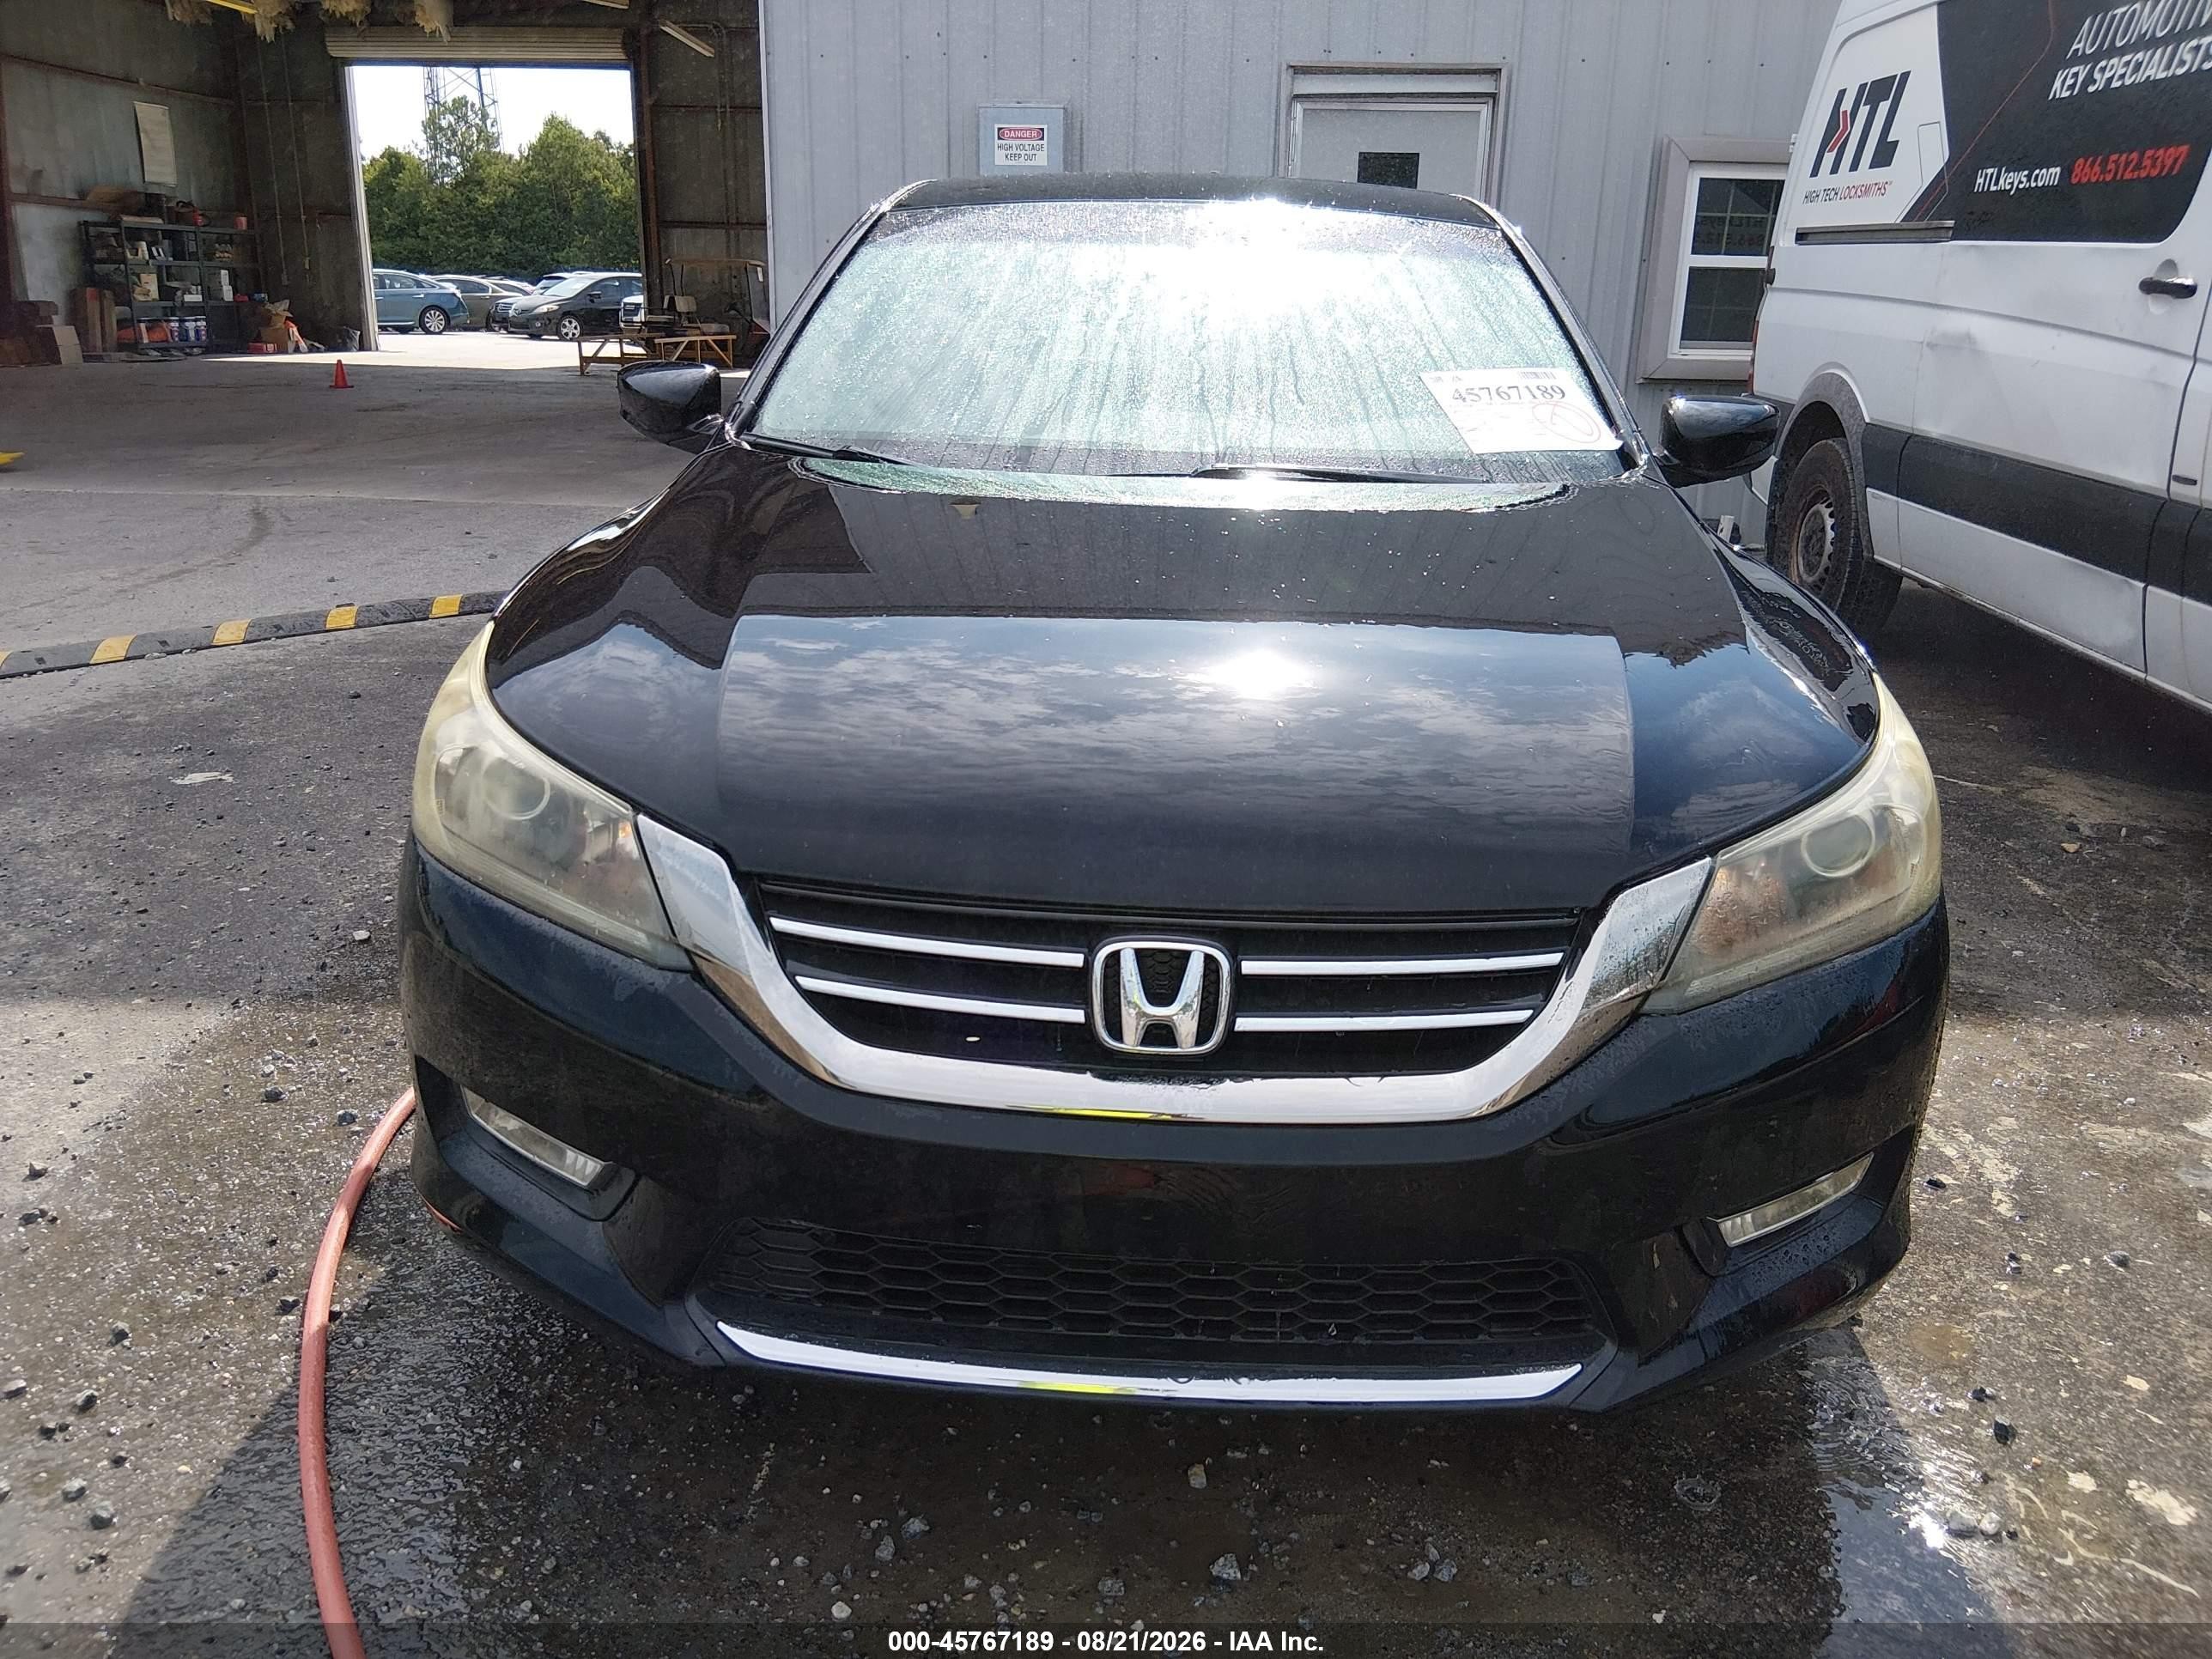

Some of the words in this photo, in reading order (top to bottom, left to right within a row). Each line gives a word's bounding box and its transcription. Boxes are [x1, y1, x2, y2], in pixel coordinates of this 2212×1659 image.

[2048, 62, 2094, 100] KEY
[1004, 130, 1037, 138] DANGER
[1809, 70, 1911, 178] HTL
[1005, 153, 1023, 161] KEEP
[1023, 153, 1037, 161] OUT
[1014, 143, 1045, 152] VOLTAGE
[2070, 144, 2190, 185] 866.512.5397
[1802, 189, 1821, 204] HIGH
[1820, 186, 1841, 203] TECH
[1839, 180, 1888, 201] LOCKSMITHS
[1973, 166, 2061, 196] HTLkeys.com
[1451, 384, 1566, 403] 45767189
